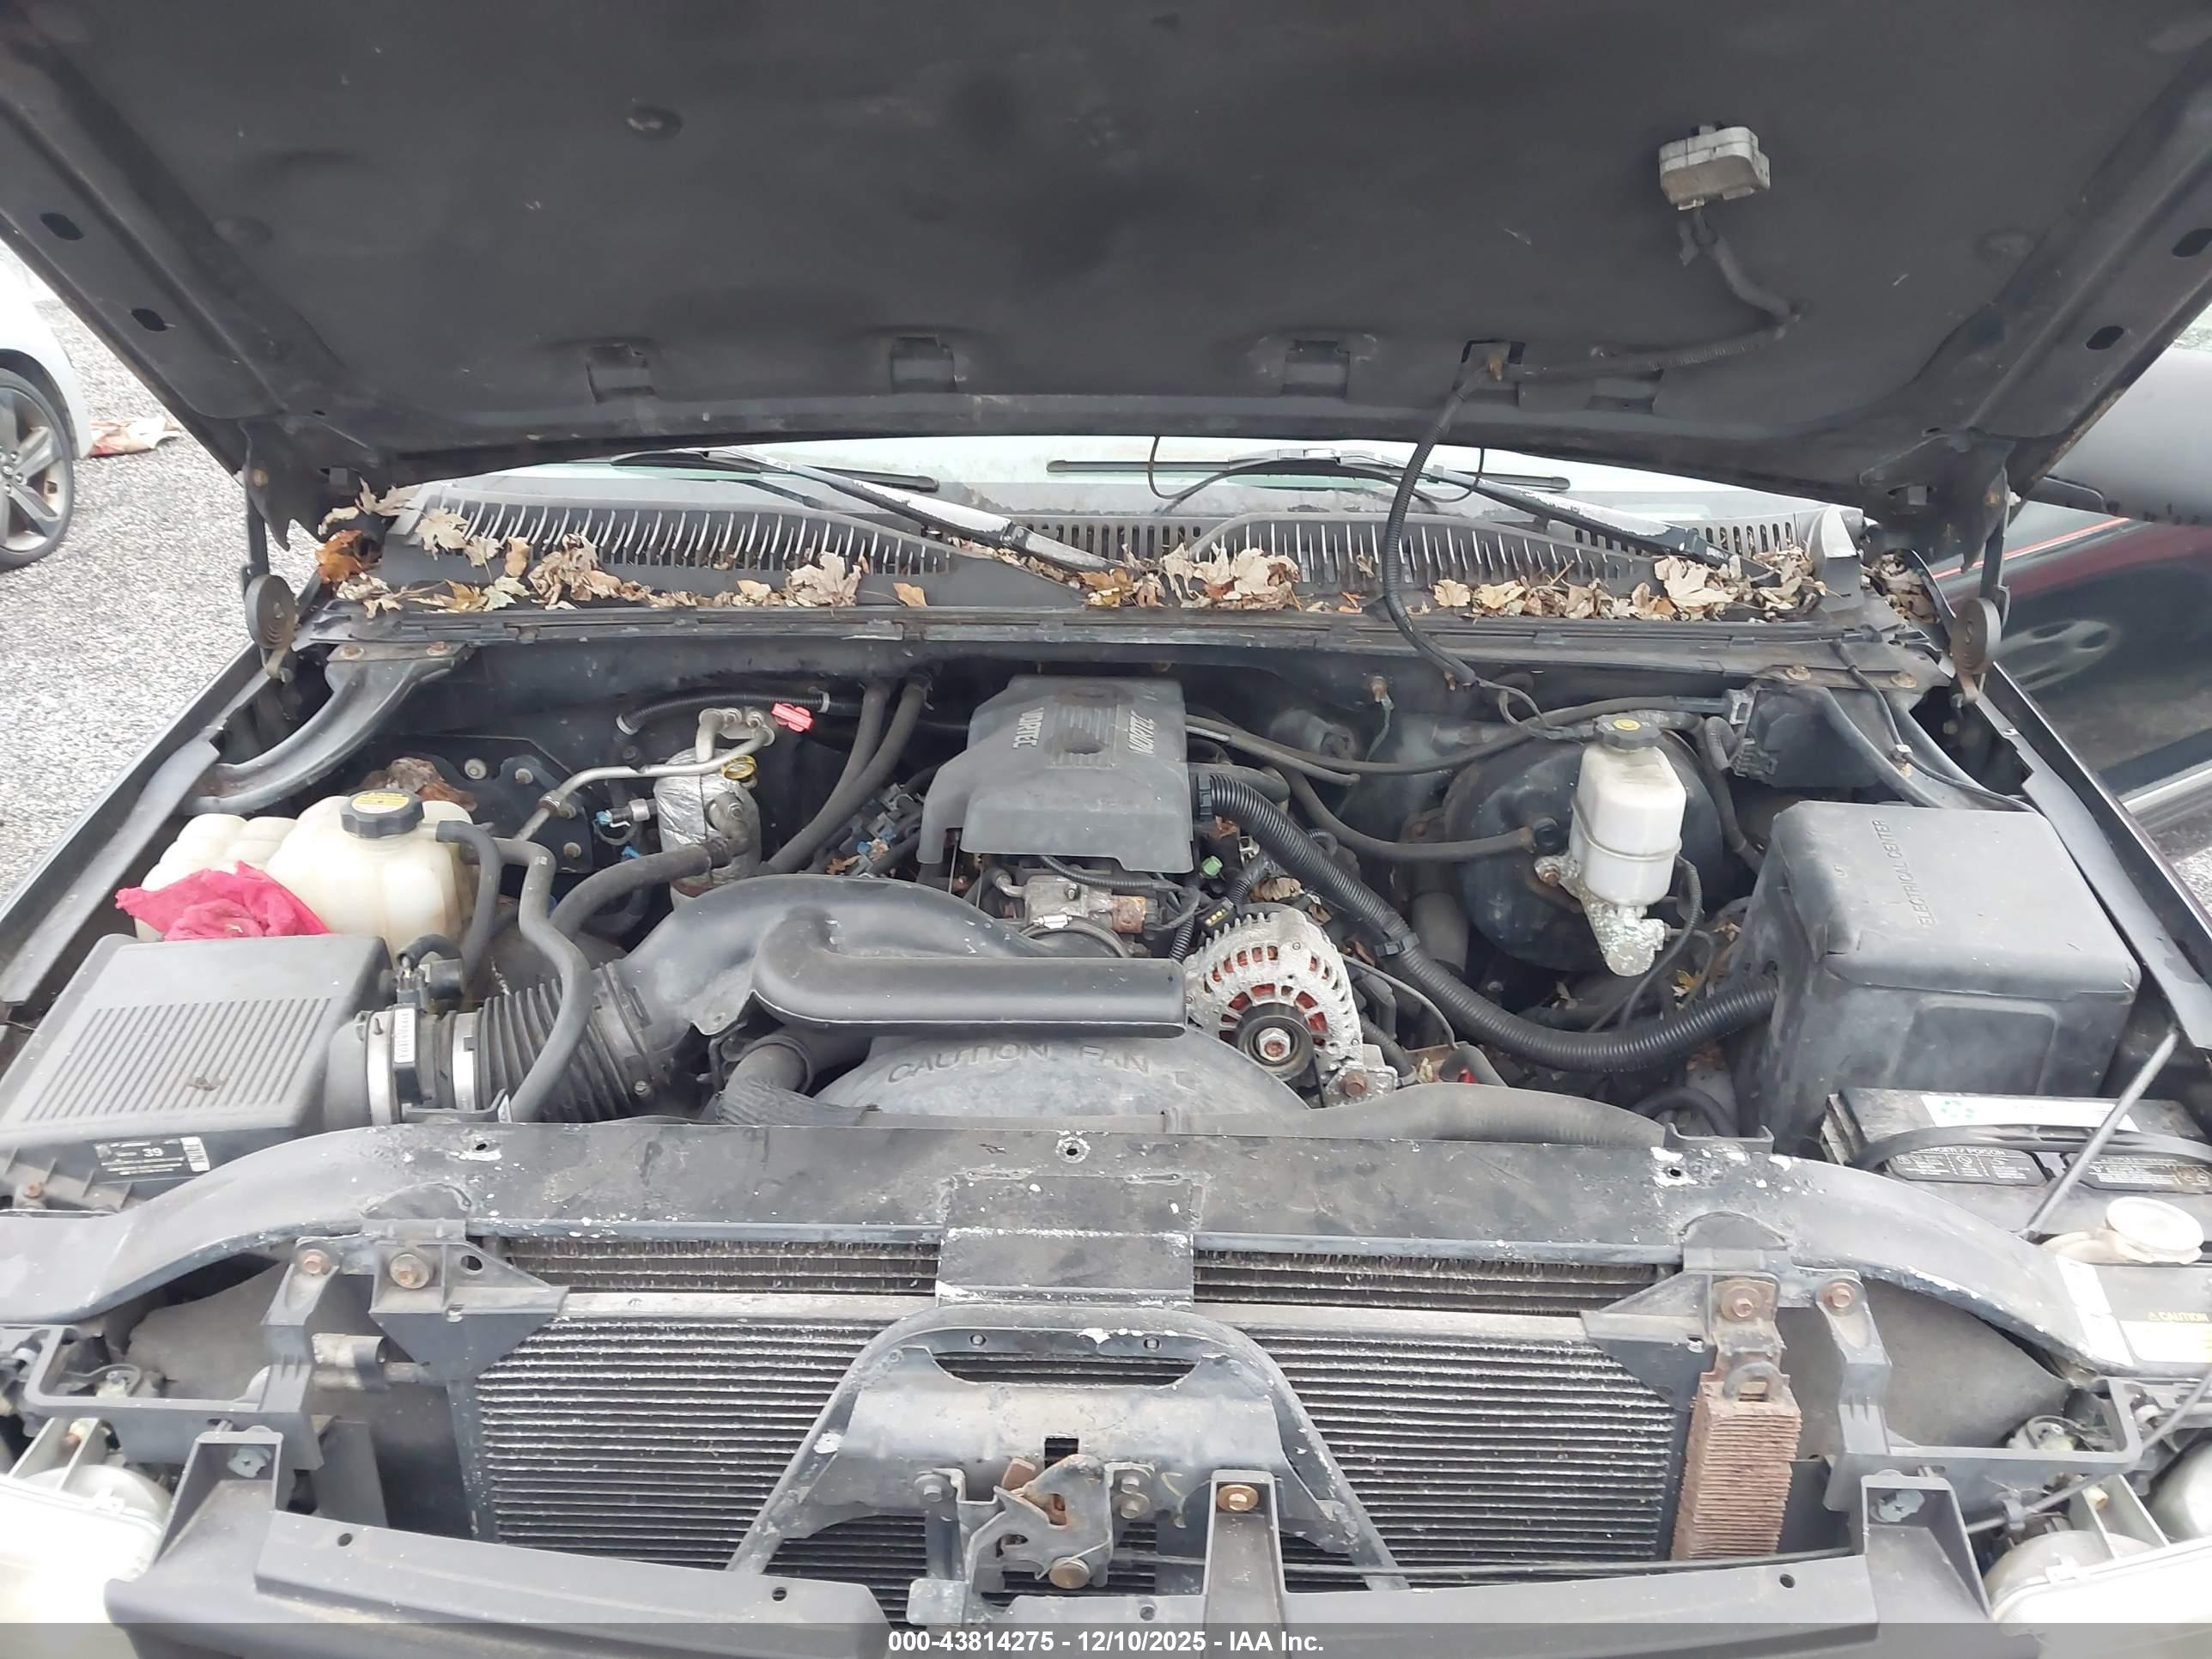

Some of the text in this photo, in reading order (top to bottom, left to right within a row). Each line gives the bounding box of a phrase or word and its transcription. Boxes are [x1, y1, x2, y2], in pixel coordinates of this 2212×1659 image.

[1012, 707, 1045, 750] VORTEC
[1127, 709, 1156, 756] VORTEC
[1872, 819, 1936, 926] ELECTRICAL CENTER
[887, 1042, 1151, 1085] CAUTION FAN
[142, 1147, 164, 1158] 39
[2159, 1311, 2210, 1322] CAUTION
